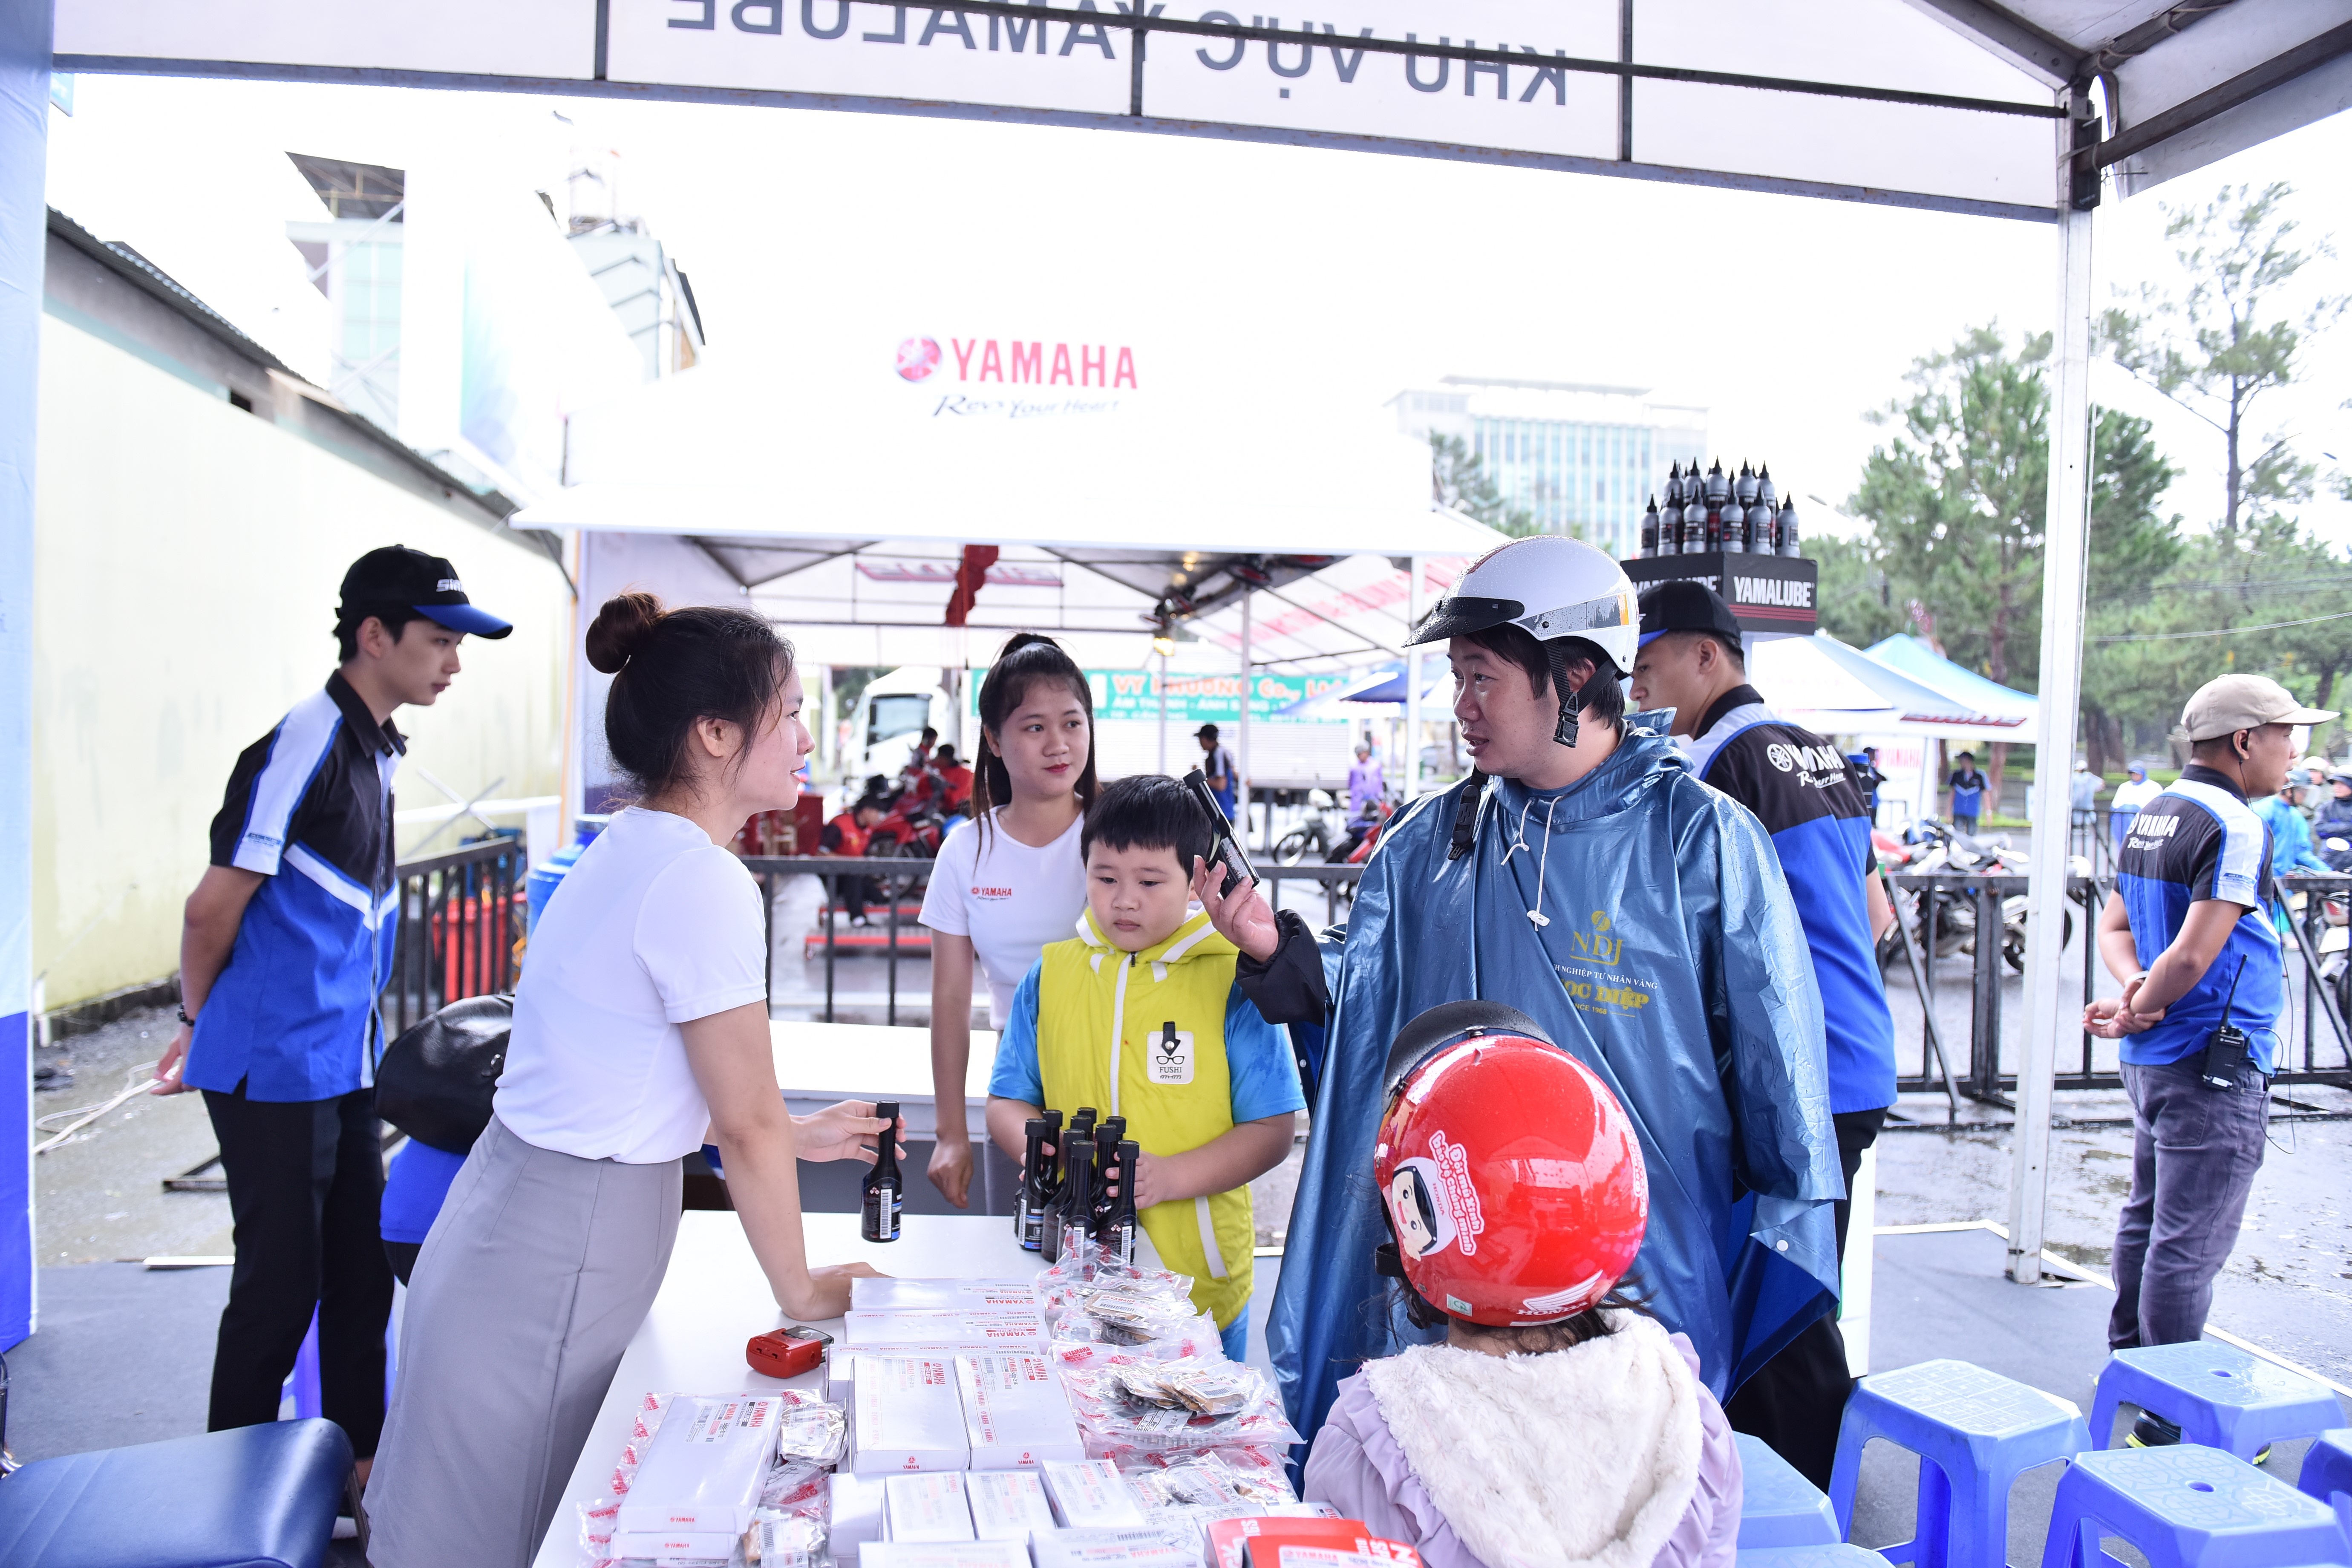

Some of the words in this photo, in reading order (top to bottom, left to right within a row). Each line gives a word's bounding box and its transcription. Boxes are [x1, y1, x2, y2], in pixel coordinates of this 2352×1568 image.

[951, 338, 1137, 389] YAMAHA
[1733, 576, 1811, 607] YAMALUBE
[981, 888, 1012, 896] YAMAHA
[1562, 966, 1592, 978] NGHIỆP
[1594, 971, 1605, 980] TƯ
[1607, 974, 1631, 985] NHÂN
[1634, 978, 1658, 989] VÀNG
[1592, 1006, 1607, 1015] 1968
[1433, 1182, 1445, 1216] HONDA
[1516, 1302, 1588, 1315] HONDA
[1067, 1346, 1091, 1355] YAMAHA
[1008, 1360, 1017, 1372] YAMAHA
[1033, 1363, 1049, 1381] YAMAHA
[932, 1368, 946, 1385] YAMAHA
[723, 1407, 737, 1420] YAMAHA
[749, 1407, 767, 1427] YAMAHA
[1198, 1468, 1220, 1485] YAMAHA
[1139, 1486, 1155, 1502] YAMAHA
[1130, 1548, 1170, 1558] YAMAHA
[1295, 1550, 1339, 1563] YAMAHA
